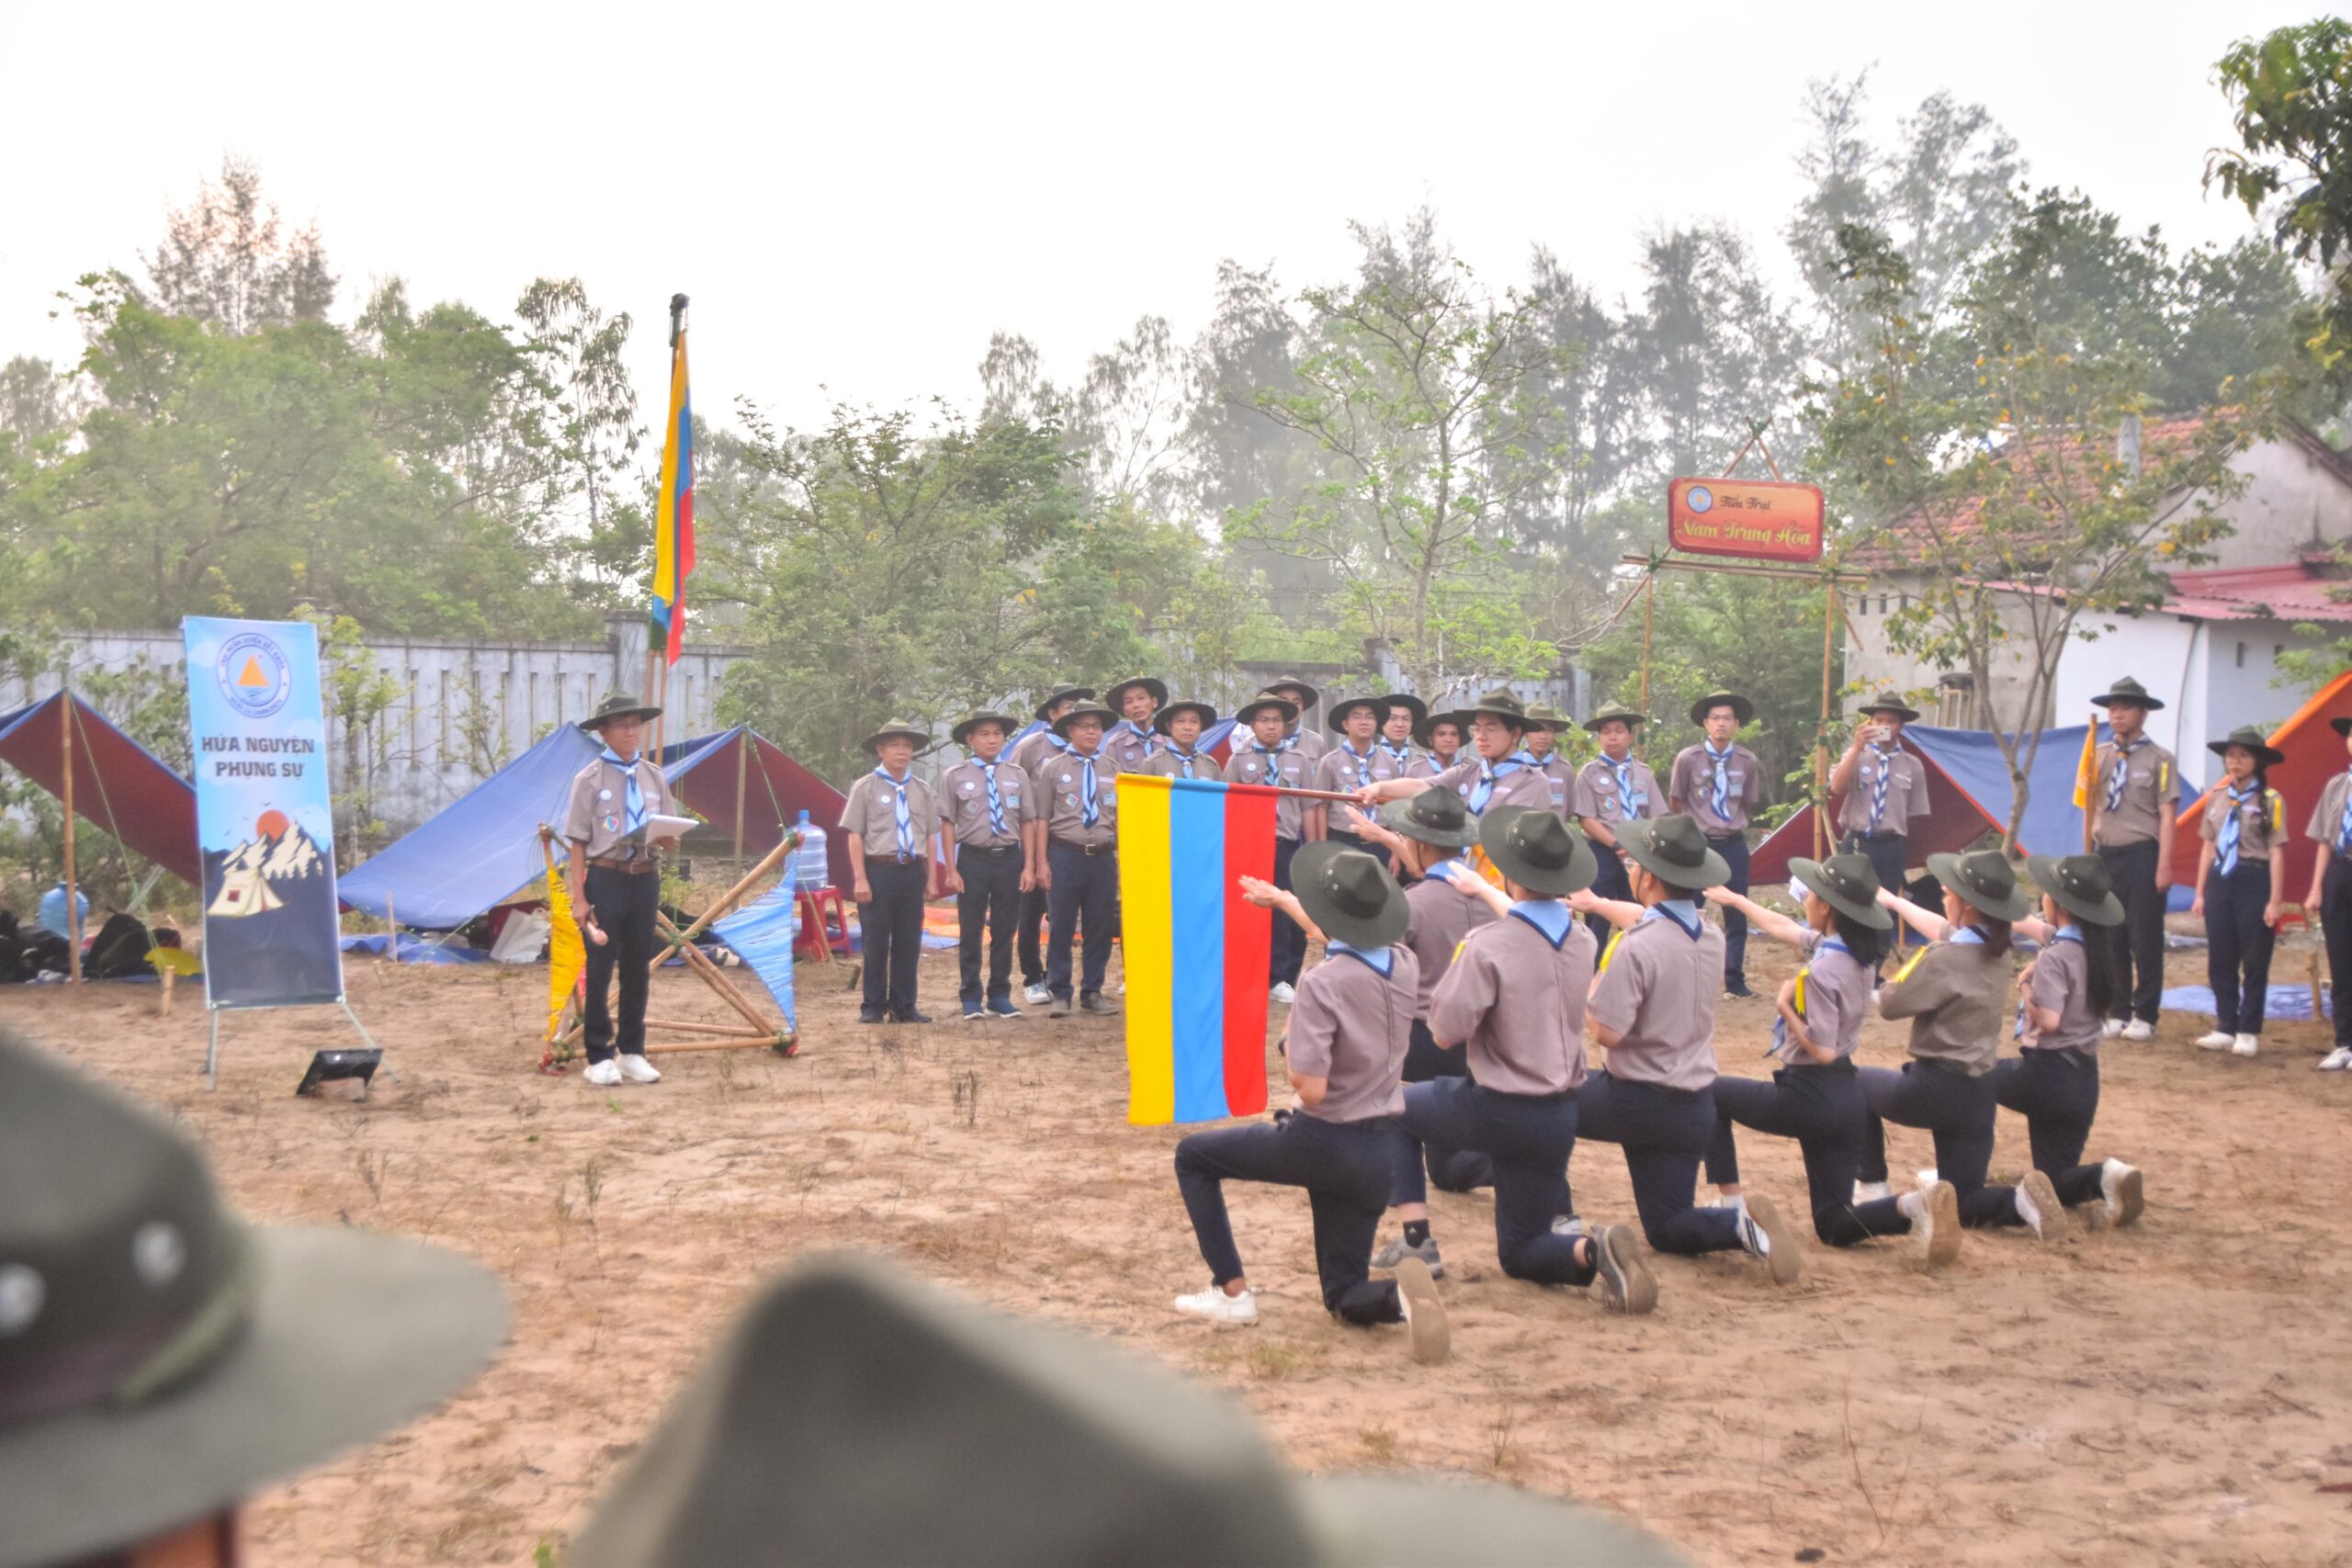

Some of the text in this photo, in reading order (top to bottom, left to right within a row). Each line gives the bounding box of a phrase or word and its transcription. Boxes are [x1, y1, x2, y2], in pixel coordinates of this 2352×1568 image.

[1724, 521, 1772, 545] Trung
[201, 733, 315, 756] HỨA NGUYỆN
[216, 761, 277, 779] PHỤNG
